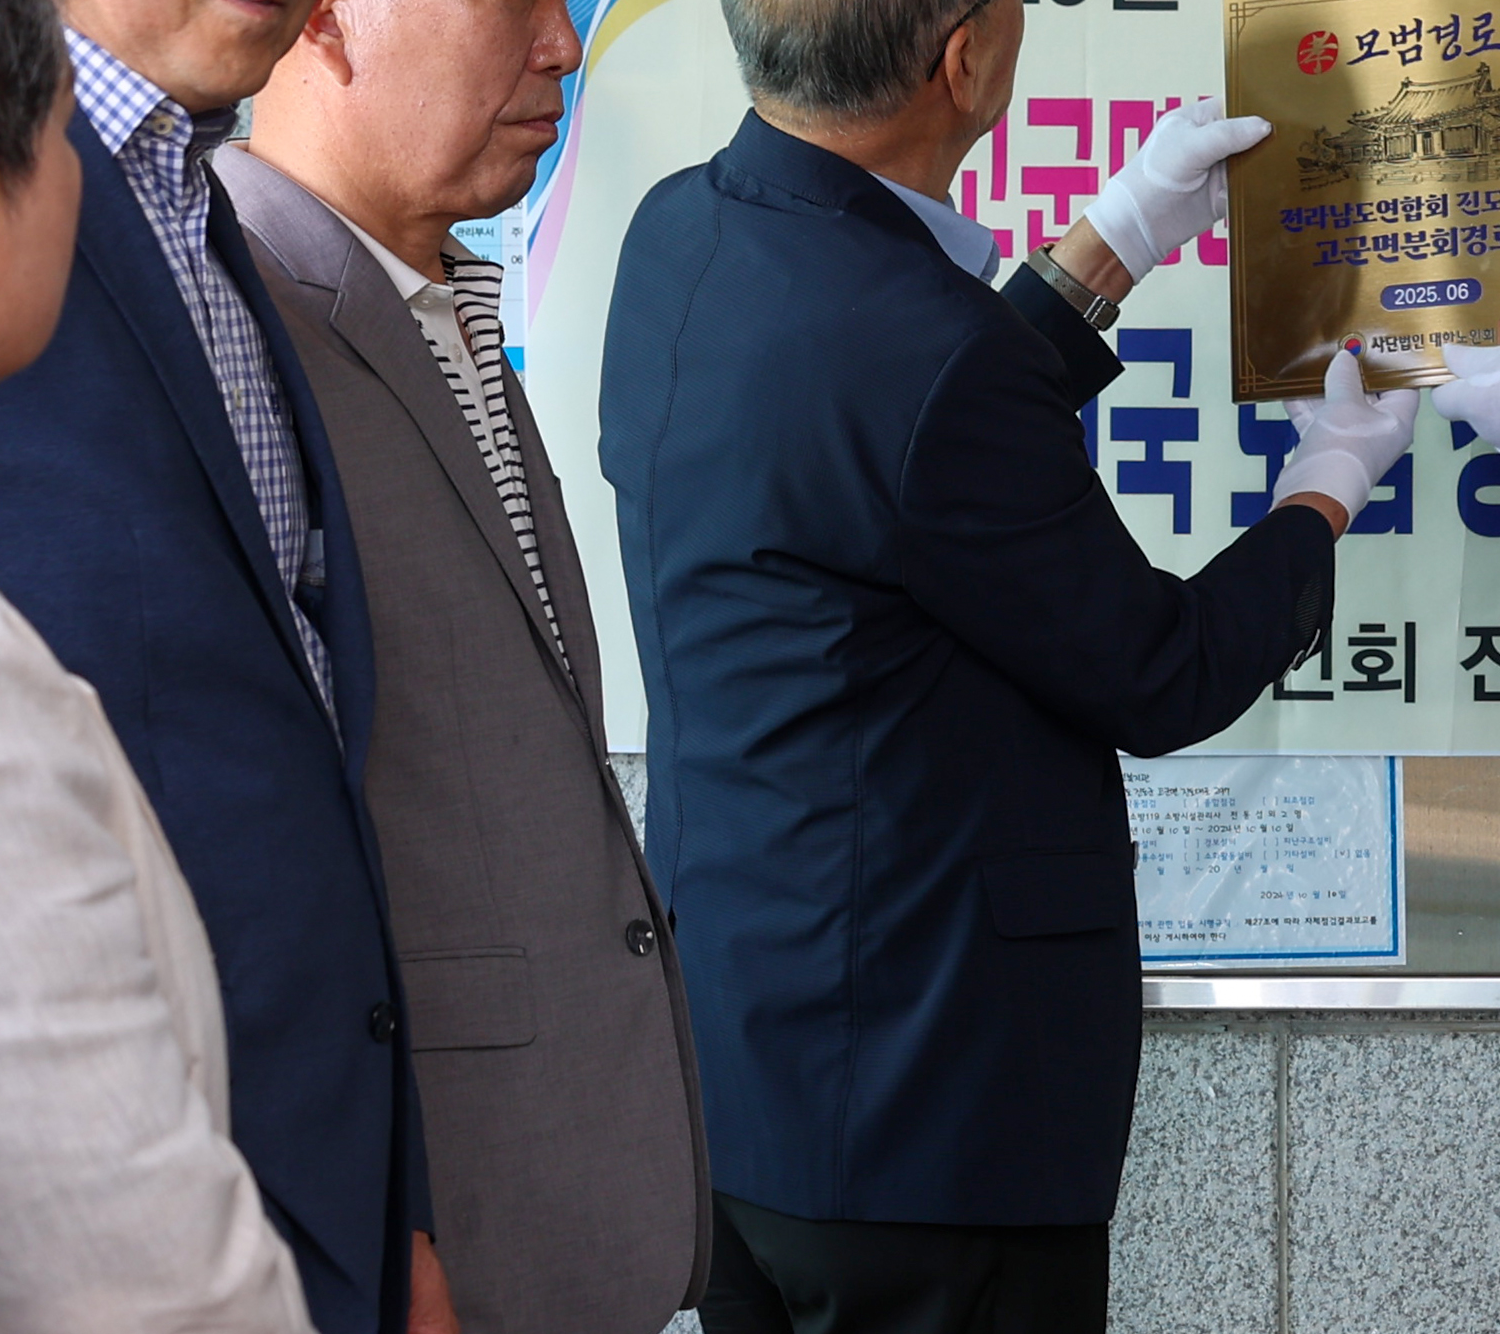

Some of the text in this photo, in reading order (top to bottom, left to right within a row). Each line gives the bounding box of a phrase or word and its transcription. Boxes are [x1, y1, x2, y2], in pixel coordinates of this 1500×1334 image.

[1280, 193, 1450, 234] 전라남도연합회
[1393, 282, 1469, 306] 2025. 06
[1371, 334, 1425, 353] 사단법인
